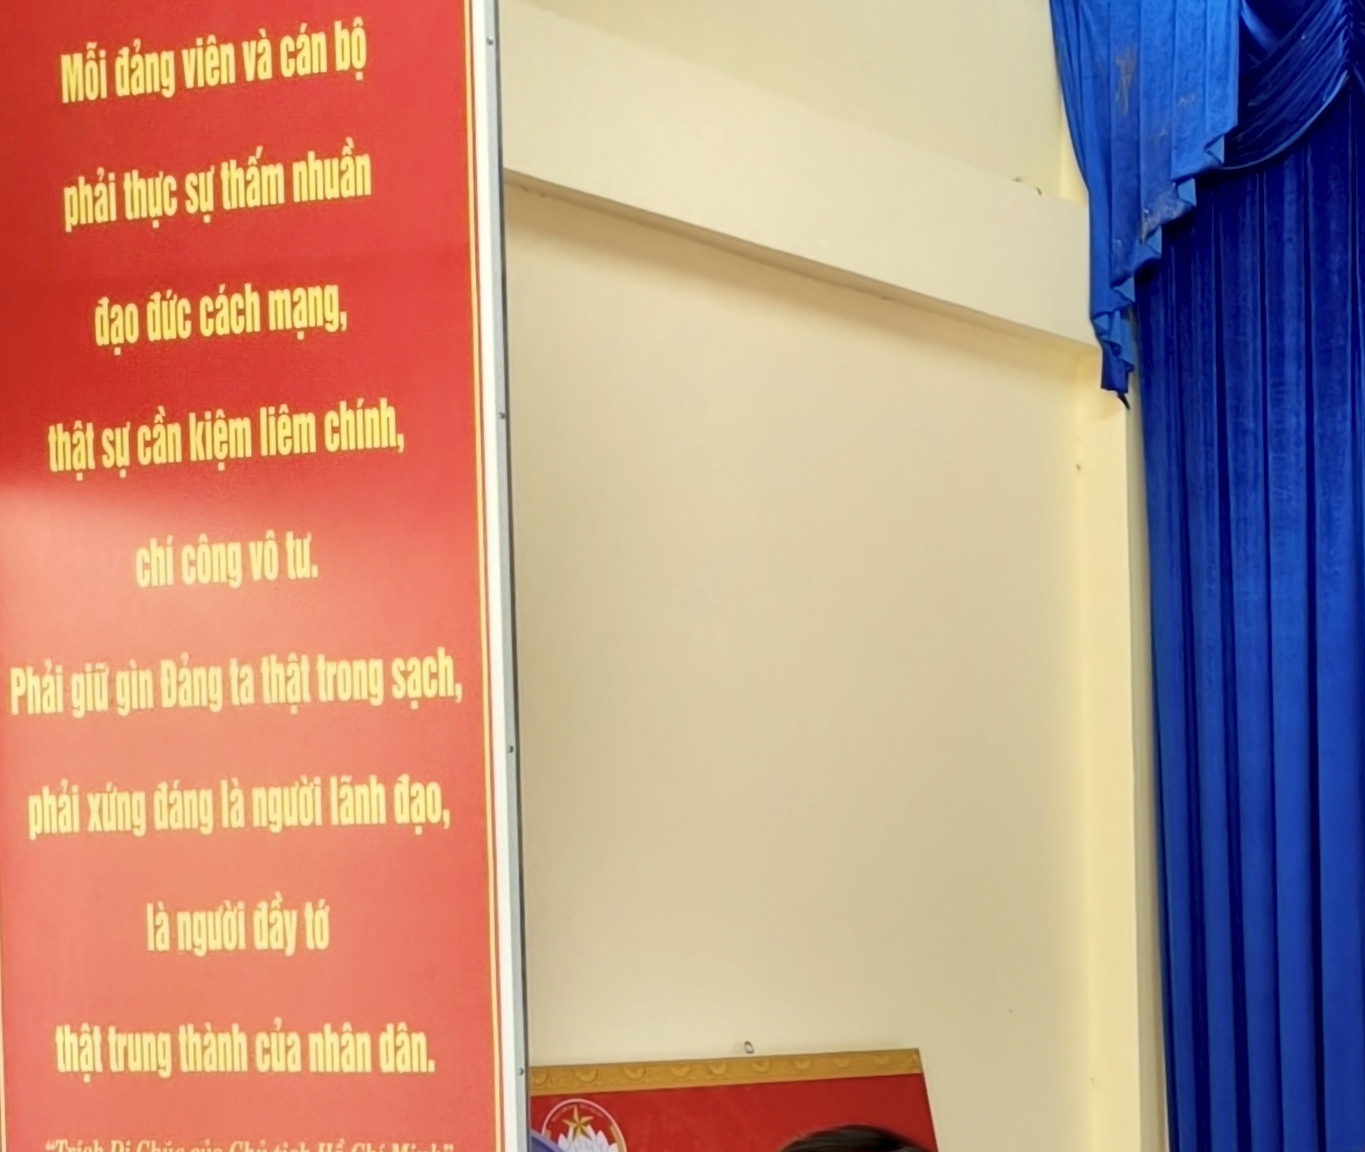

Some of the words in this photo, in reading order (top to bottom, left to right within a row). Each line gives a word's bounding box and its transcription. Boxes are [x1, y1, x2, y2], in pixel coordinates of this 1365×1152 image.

[61, 42, 107, 103] Mỗi
[115, 39, 175, 97] đảng
[182, 35, 235, 88] viên
[242, 29, 272, 81] và
[280, 23, 327, 77] cán
[335, 17, 366, 80] bộ
[64, 168, 116, 232] phải
[123, 170, 177, 228] thực
[185, 166, 214, 223] sự
[220, 146, 285, 210] thấm
[293, 138, 371, 202] nhuần
[95, 297, 139, 355] đạo
[147, 290, 191, 341] đức
[200, 283, 260, 336] cách
[269, 285, 347, 339] mạng,
[48, 421, 95, 481] thật
[102, 422, 130, 478] sự
[138, 406, 182, 465] cần
[190, 409, 252, 471] kiệm
[260, 404, 316, 456] liêm
[325, 398, 404, 452] chính,
[136, 537, 173, 587] chí
[181, 534, 242, 588] công
[249, 530, 278, 581] vô
[286, 532, 318, 579] tư.
[11, 659, 63, 714] Phải
[71, 663, 109, 718] giữ
[116, 660, 153, 716] gìn
[160, 653, 222, 712] Đảng
[230, 658, 254, 705] ta
[261, 653, 311, 713] thật
[317, 654, 383, 706] trong
[392, 647, 462, 709] sạch,
[29, 779, 79, 840] phải
[87, 783, 146, 836] xứng
[154, 780, 213, 834] đáng
[221, 778, 244, 828] là
[252, 776, 322, 832] người
[330, 775, 386, 825] lãnh
[394, 774, 450, 834] đạo,
[147, 902, 170, 951] là
[177, 901, 245, 956] người
[253, 896, 297, 955] đầy
[304, 899, 329, 949] tớ
[55, 1023, 102, 1082] thật
[108, 1026, 172, 1078] trung
[178, 1023, 248, 1072] thành
[255, 1018, 301, 1072] của
[309, 1022, 371, 1072] nhân
[379, 1022, 435, 1073] dân.
